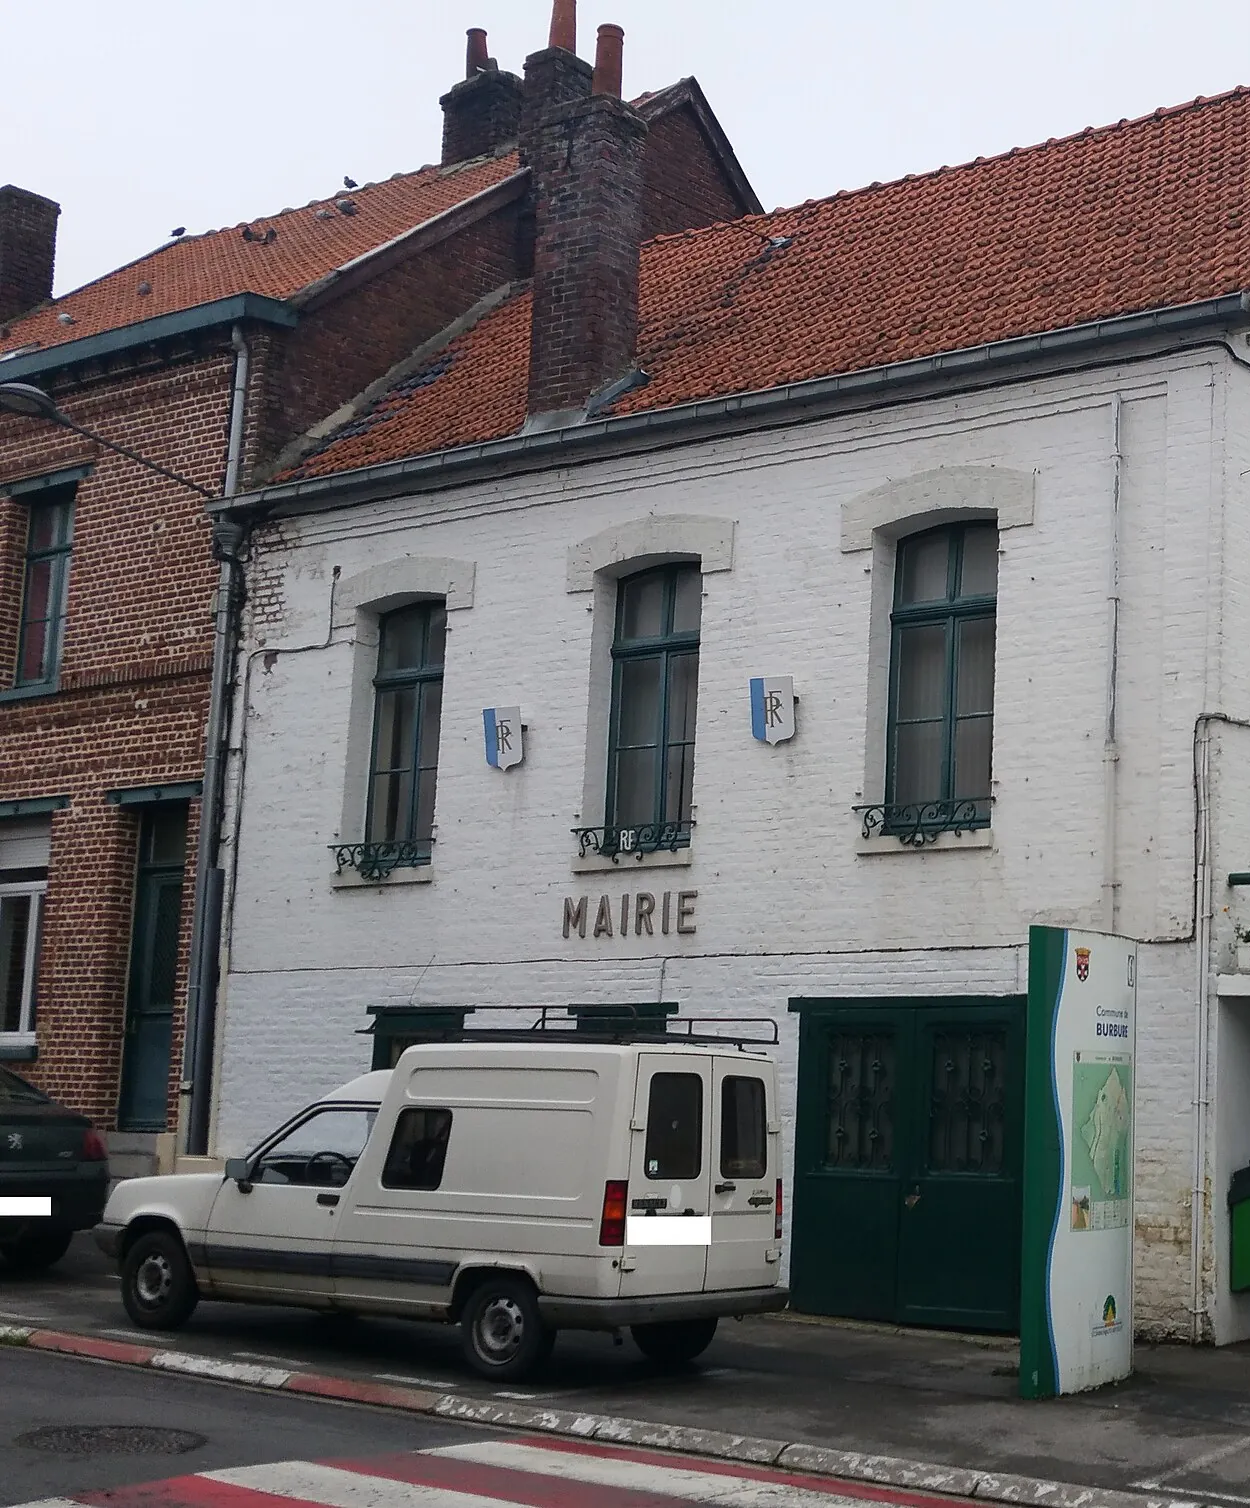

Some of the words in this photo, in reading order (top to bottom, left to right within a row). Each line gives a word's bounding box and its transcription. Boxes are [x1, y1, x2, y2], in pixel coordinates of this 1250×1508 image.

[620, 829, 635, 851] RF
[562, 890, 698, 938] MAIRIE
[1096, 1005, 1124, 1018] Commune
[1096, 1023, 1128, 1038] BURBURE
